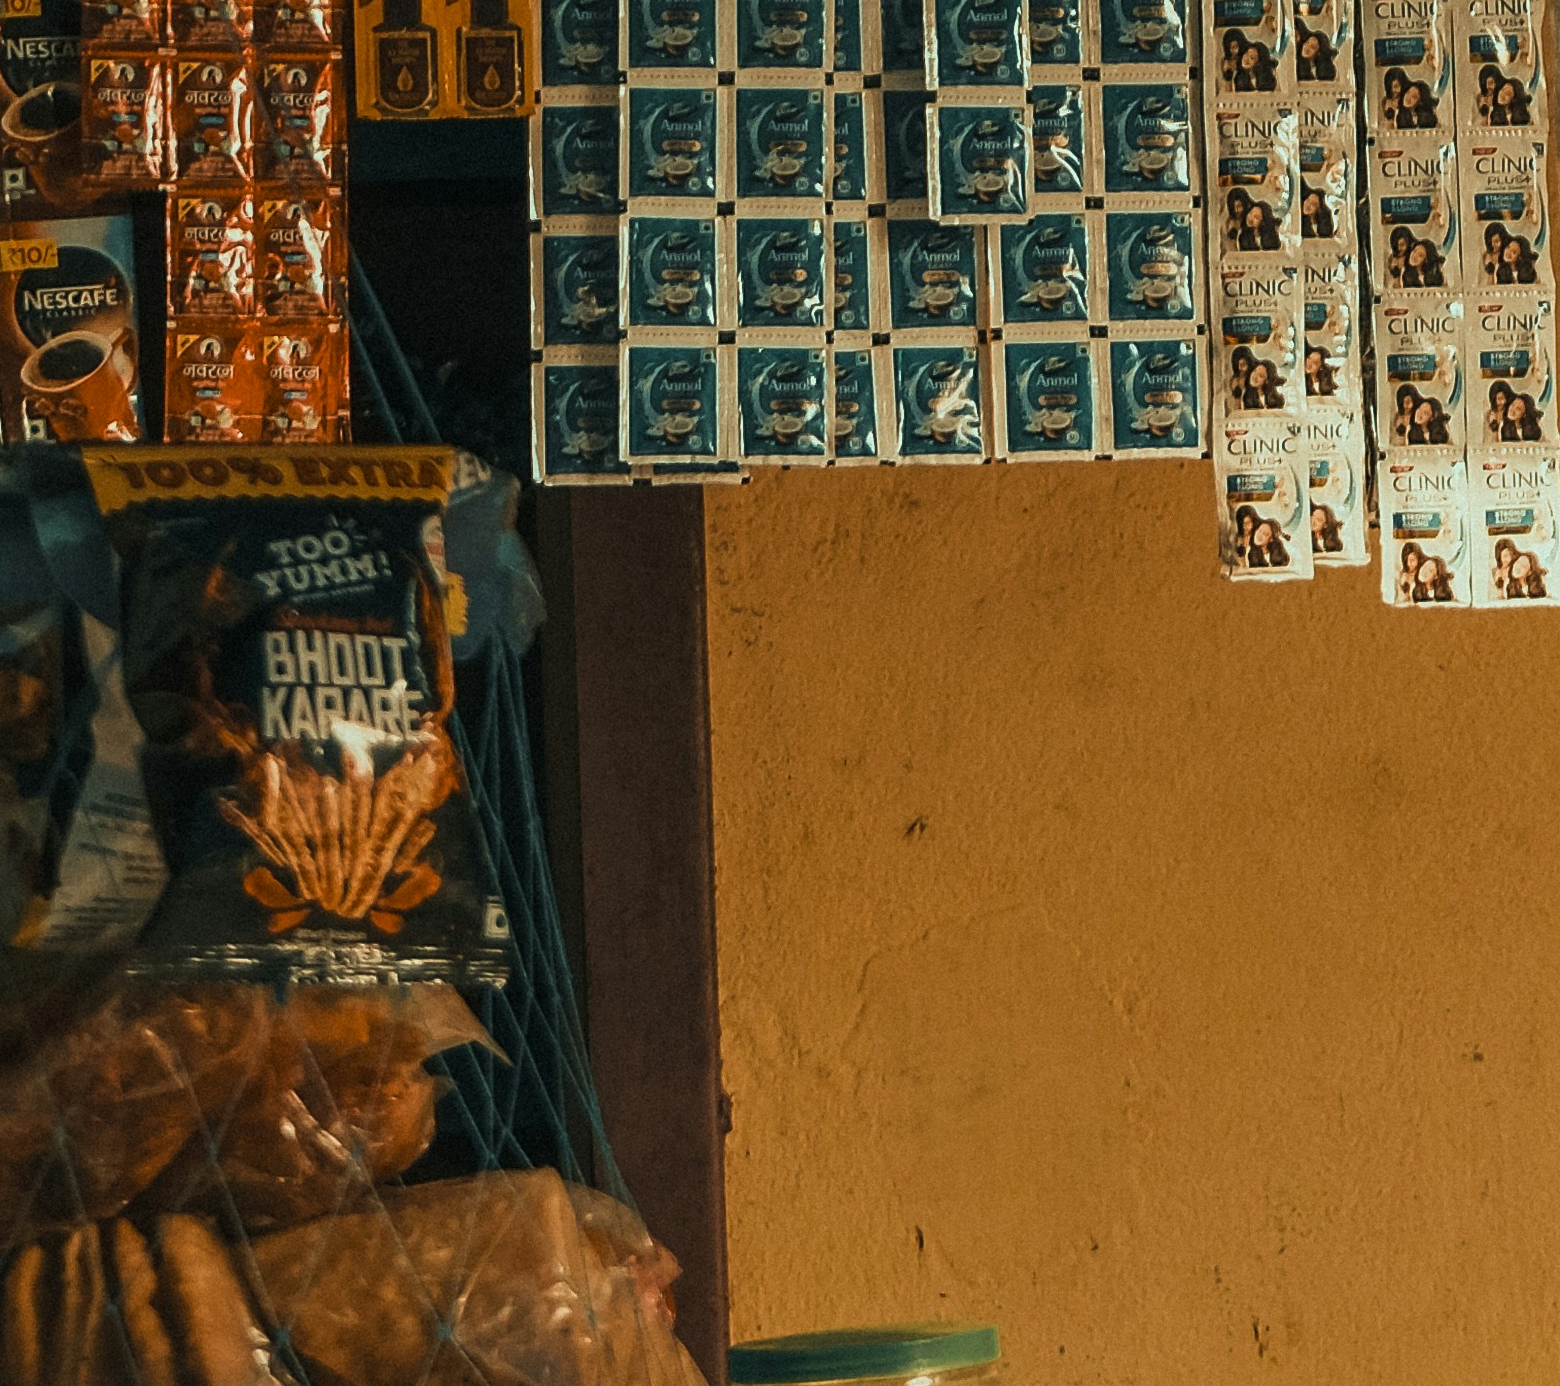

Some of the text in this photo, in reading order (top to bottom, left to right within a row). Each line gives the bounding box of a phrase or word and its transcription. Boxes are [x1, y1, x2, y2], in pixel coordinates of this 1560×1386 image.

[1224, 279, 1291, 297] CLINIC
[1228, 437, 1298, 456] CLINIC
[121, 455, 447, 492] 100% EXTRA
[270, 530, 352, 566] TOO
[254, 552, 392, 599] YUMM!
[265, 630, 409, 686] BHOOT
